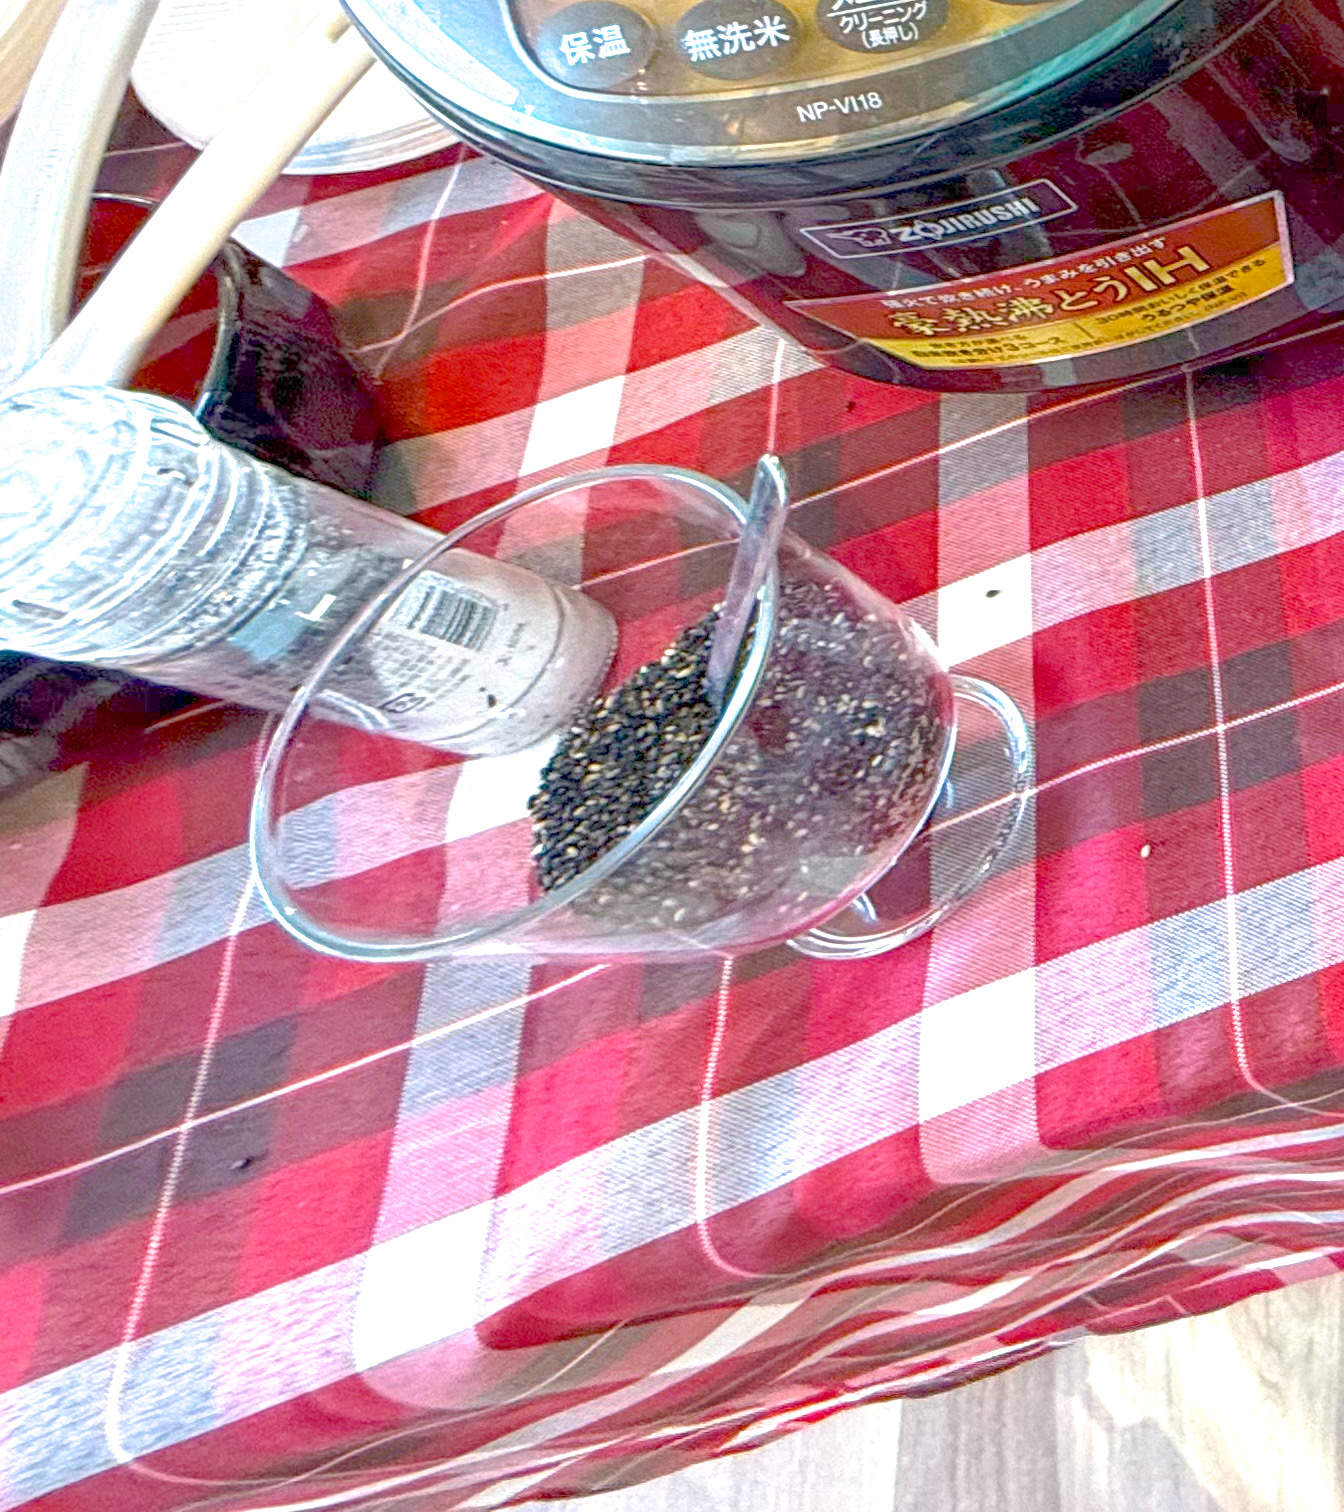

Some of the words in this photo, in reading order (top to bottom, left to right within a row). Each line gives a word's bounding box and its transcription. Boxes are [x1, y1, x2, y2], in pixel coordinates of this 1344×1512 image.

[839, 0, 928, 36] クリーニング
[861, 24, 920, 49] (長押し)
[560, 25, 631, 66] 保温
[684, 16, 791, 62] 無洗米
[795, 92, 884, 124] NP-VI18
[891, 196, 1042, 246] ZOJIRUSHI
